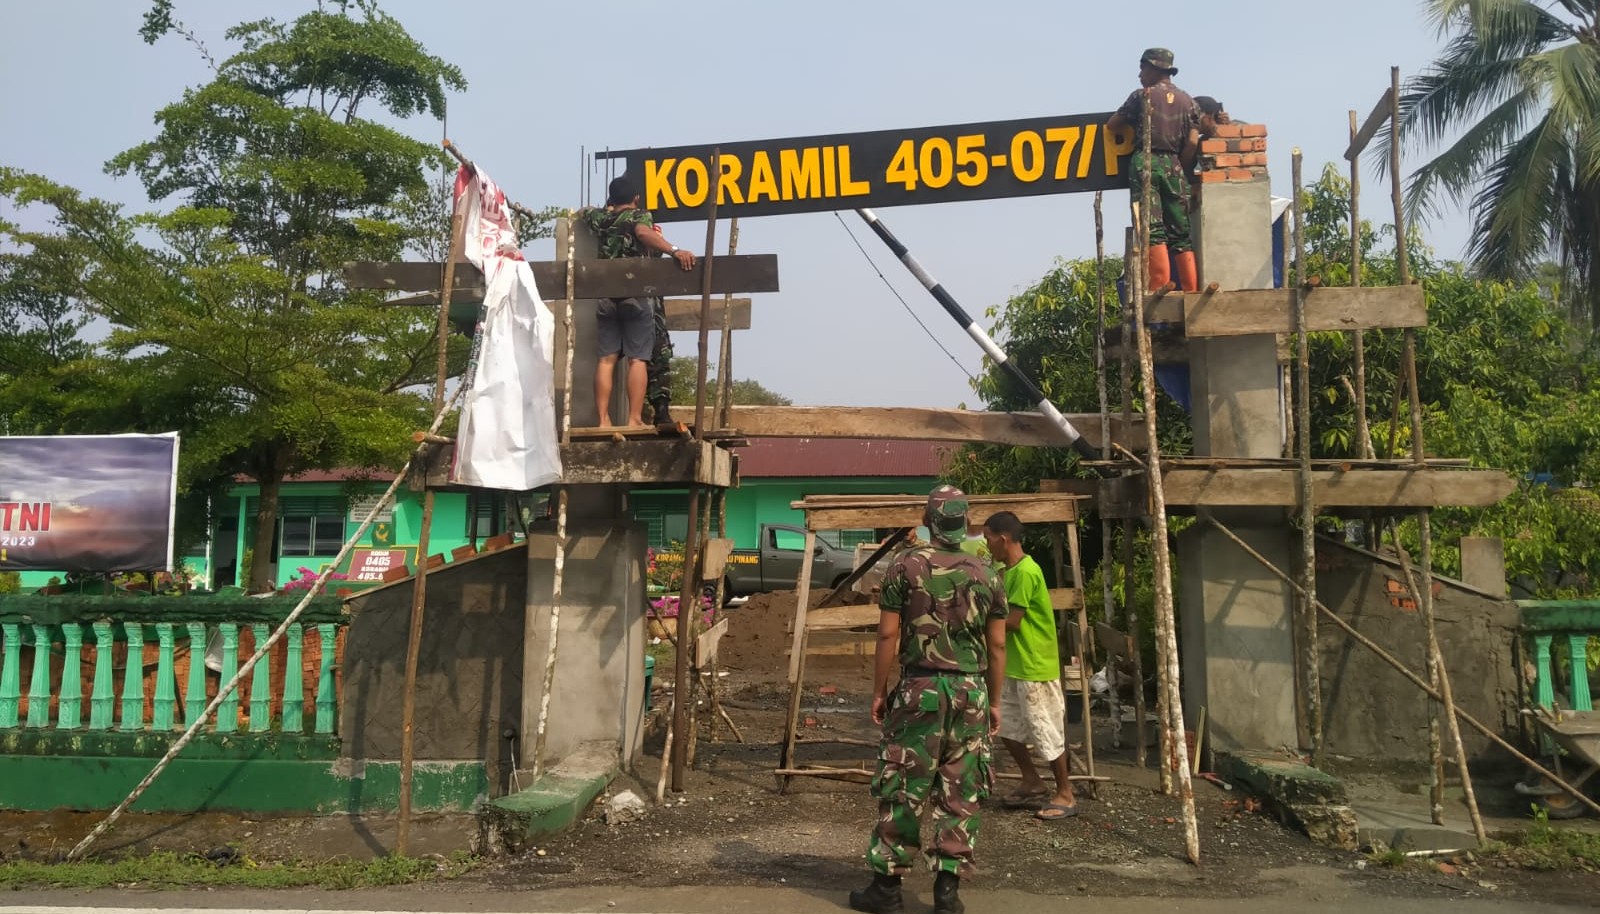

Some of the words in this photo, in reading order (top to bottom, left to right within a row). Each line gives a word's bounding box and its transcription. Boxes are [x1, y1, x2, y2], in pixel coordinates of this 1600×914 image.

[644, 145, 870, 210] KORAMIL
[0, 503, 51, 531] TNI
[2, 537, 35, 546] 2023
[365, 556, 391, 566] 0405
